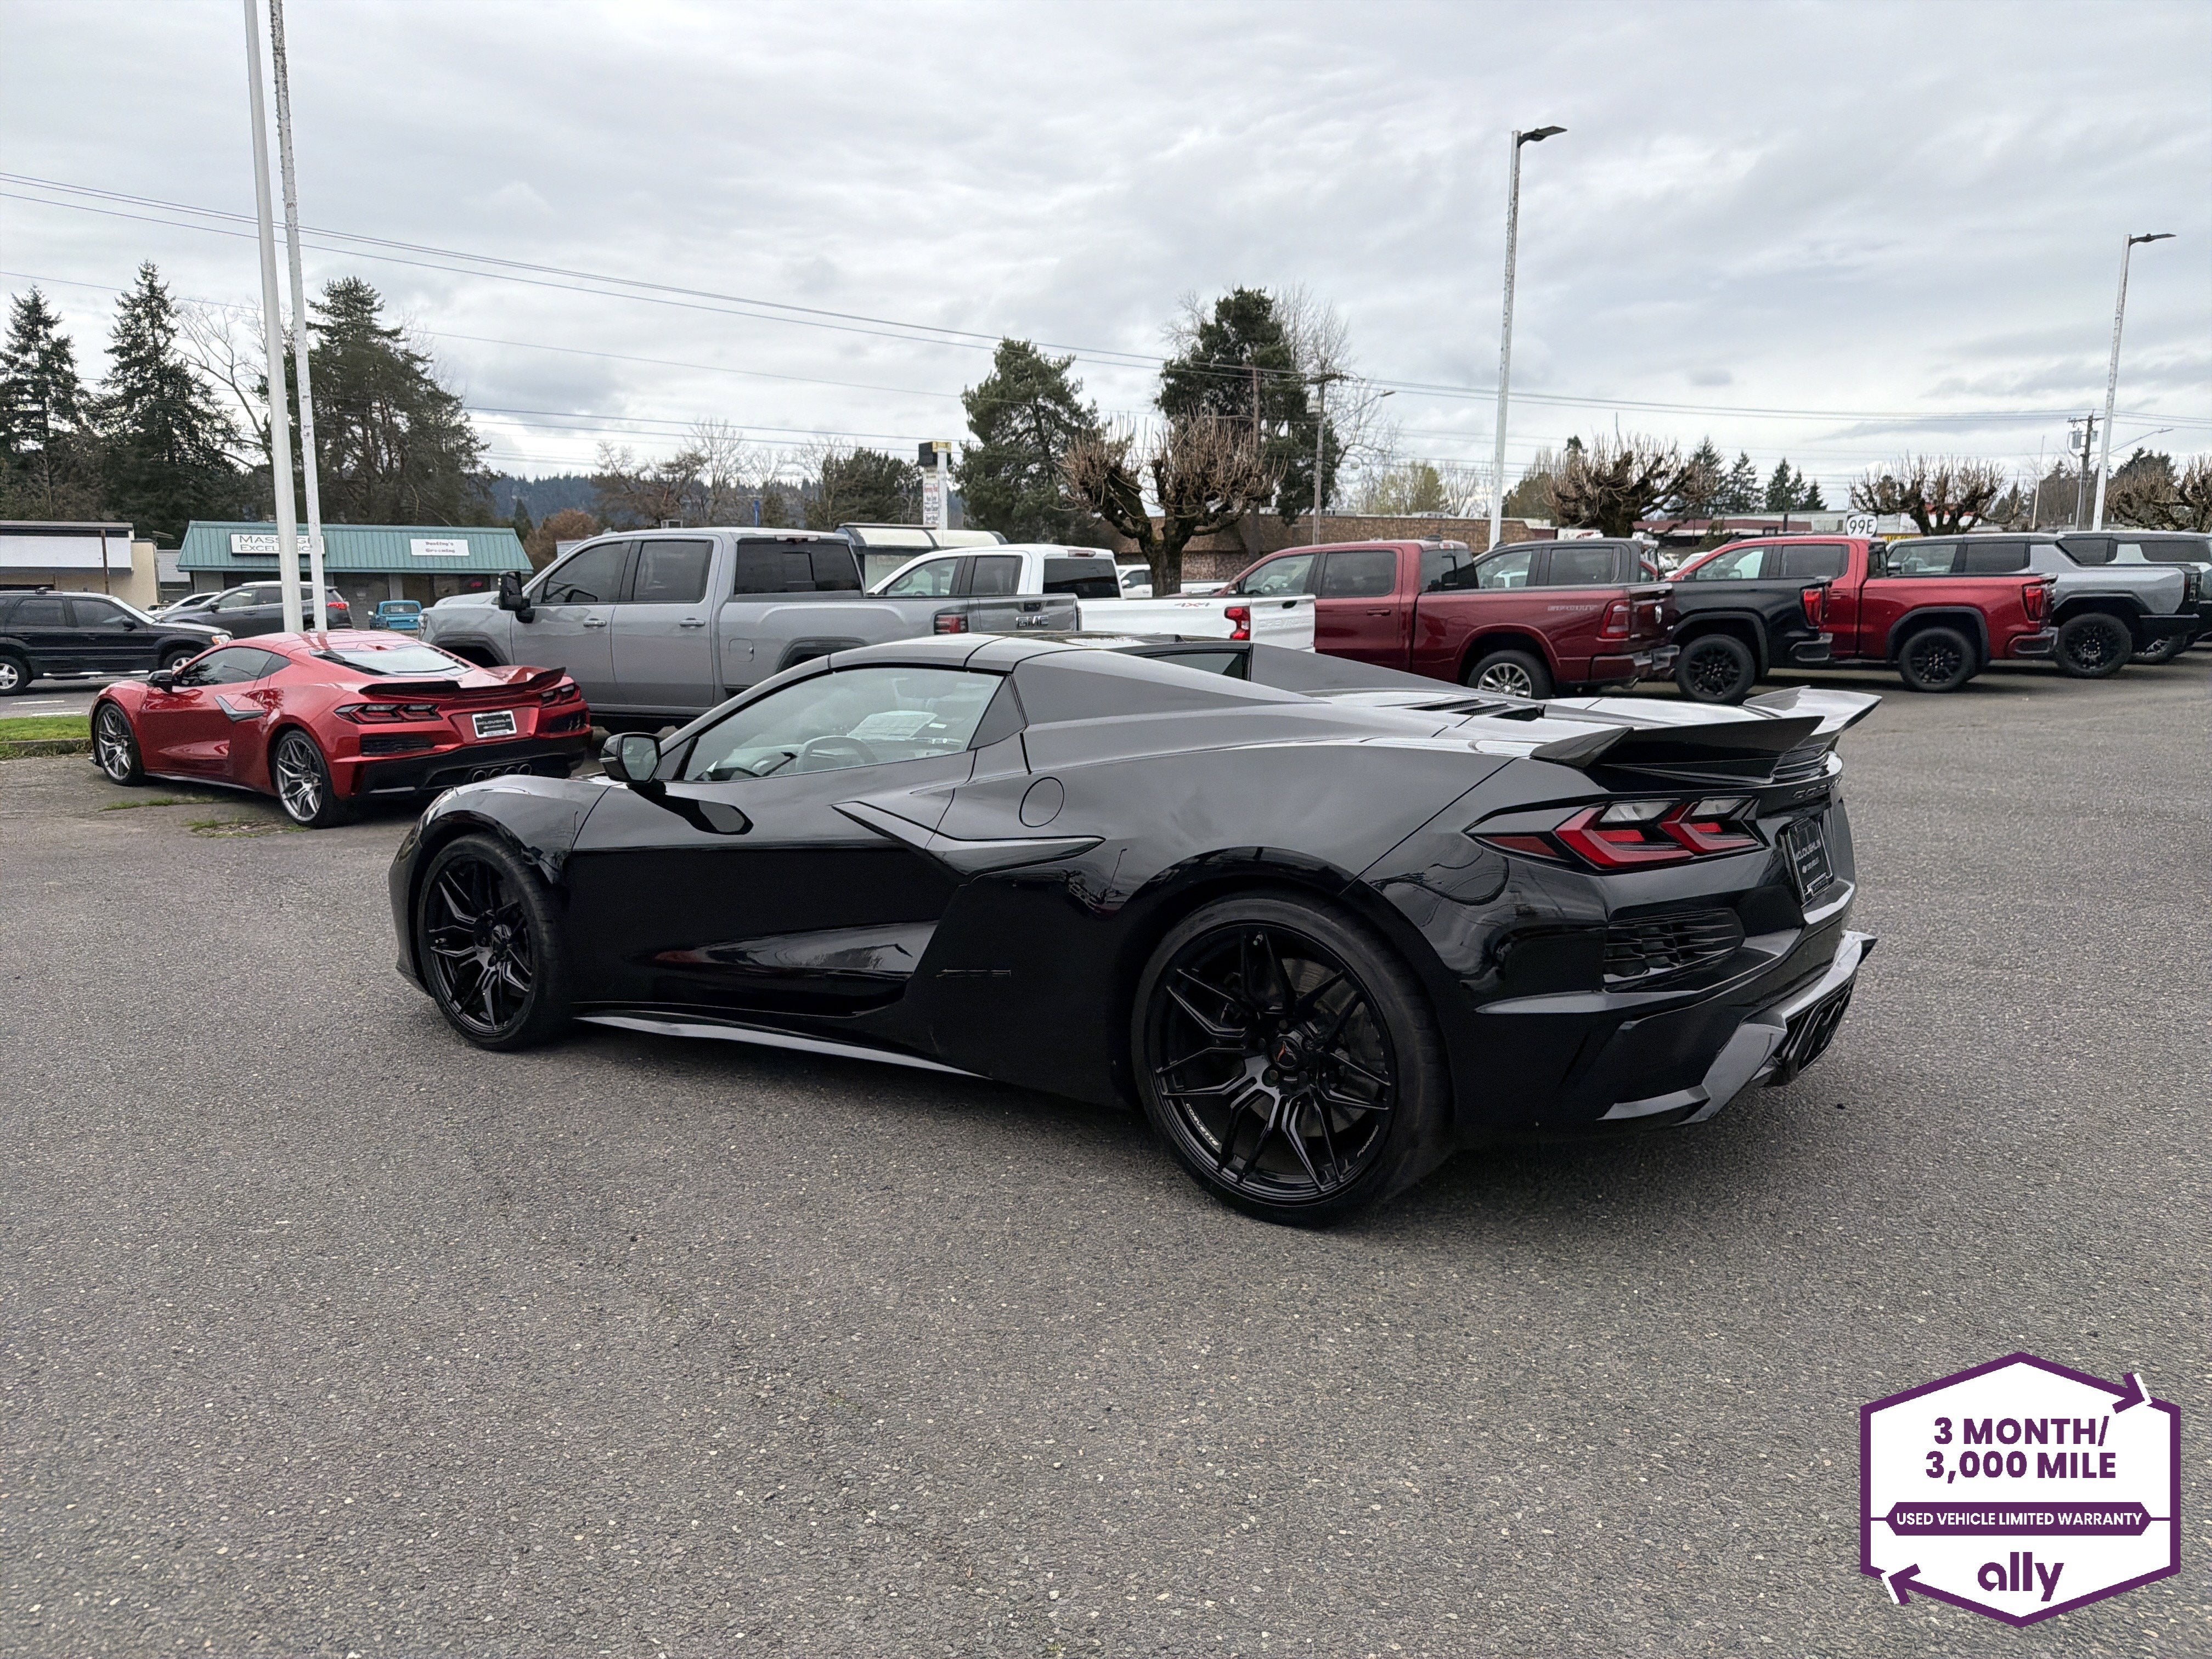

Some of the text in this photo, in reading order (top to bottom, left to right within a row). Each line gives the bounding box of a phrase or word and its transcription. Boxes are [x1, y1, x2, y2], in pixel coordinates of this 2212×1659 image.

[1849, 518, 1874, 535] 99E
[239, 535, 314, 544] MASG
[240, 544, 314, 552] EXCELC
[1015, 615, 1049, 627] GMC
[1186, 1103, 1220, 1146] CORVETTE
